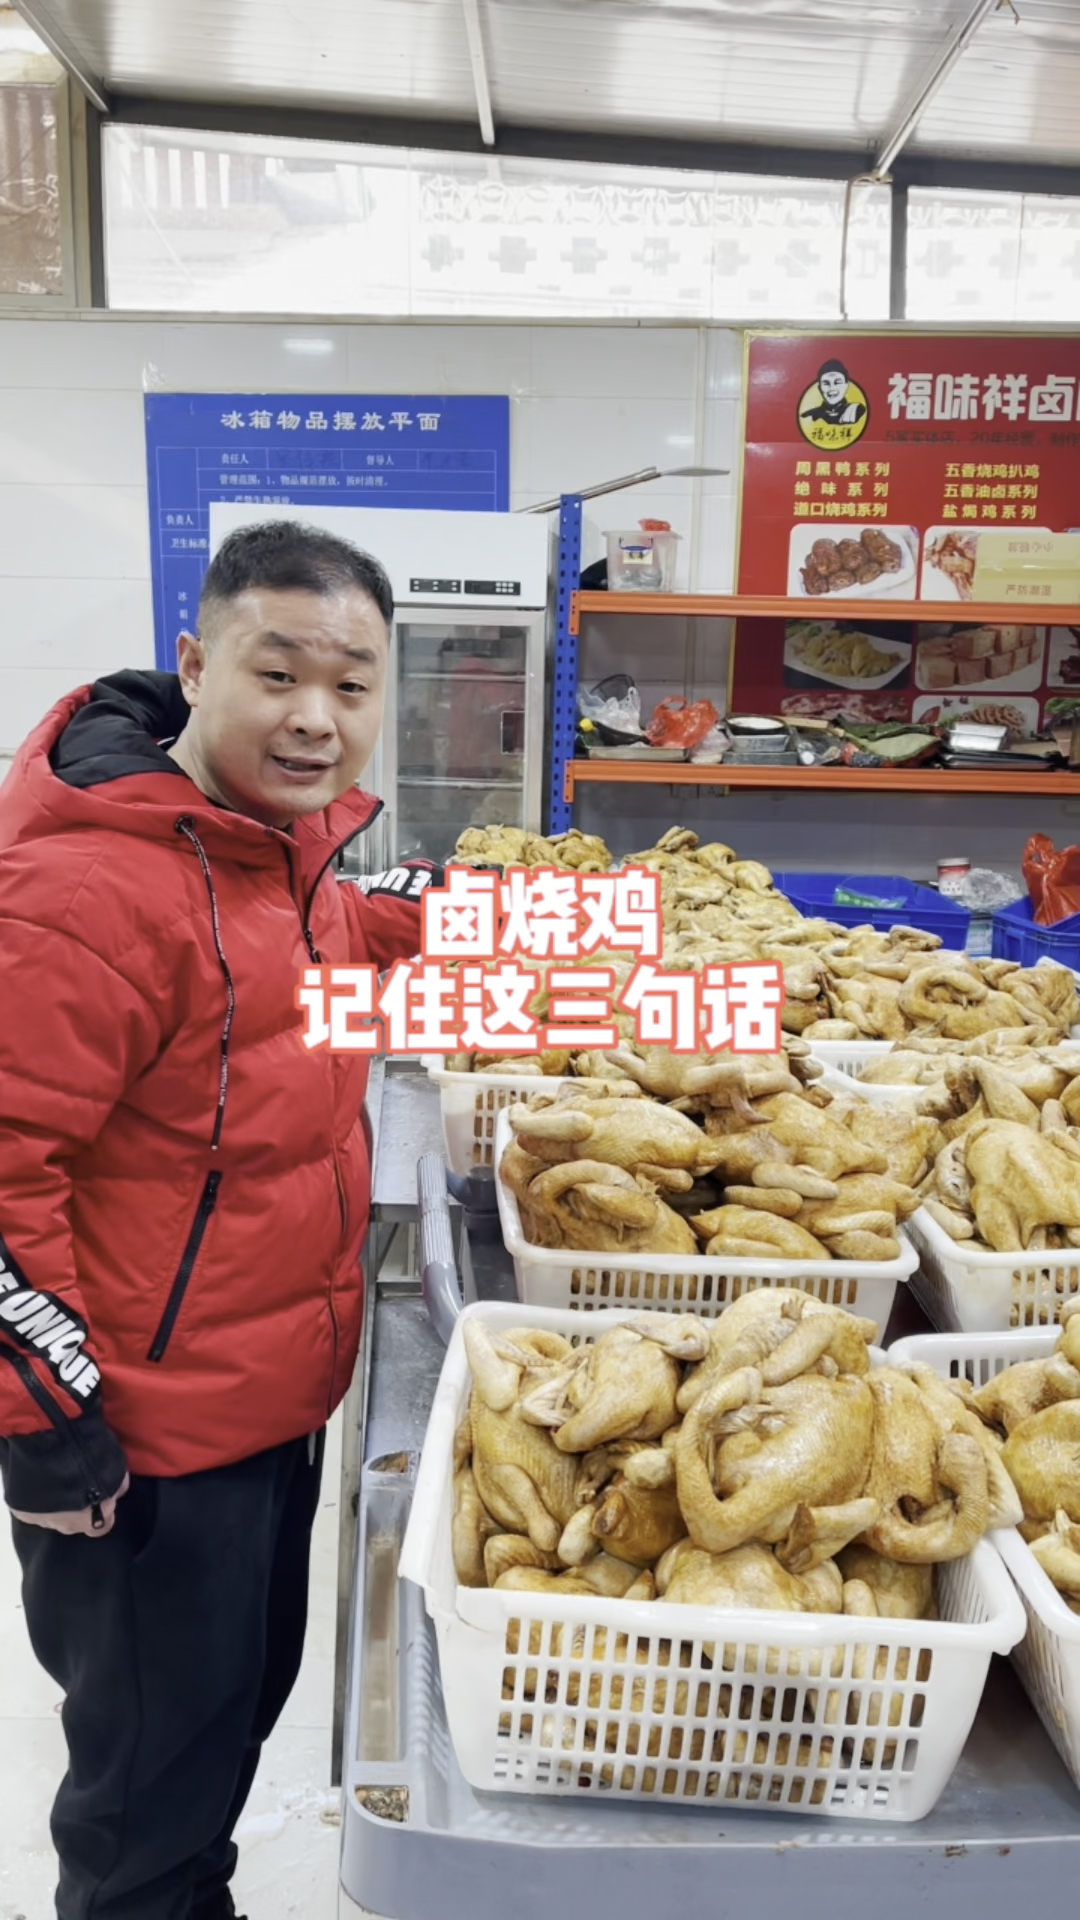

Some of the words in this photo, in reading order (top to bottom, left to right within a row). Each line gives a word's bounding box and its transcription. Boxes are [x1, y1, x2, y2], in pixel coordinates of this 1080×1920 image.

[888, 373, 1080, 421] 福味祥卤
[220, 410, 440, 431] 冰箱物品摆放平面
[221, 453, 249, 465] 责任人
[795, 461, 890, 477] 周黑鸭系列
[945, 463, 1040, 479] 五香烧鸡扒鸡
[794, 481, 889, 497] 绝味系列
[943, 484, 1038, 499] 五香油卤系列
[793, 501, 888, 517] 道口烧鸡系列
[942, 504, 1037, 519] 盐焗鸡系列
[0, 1291, 100, 1398] UNIQUE
